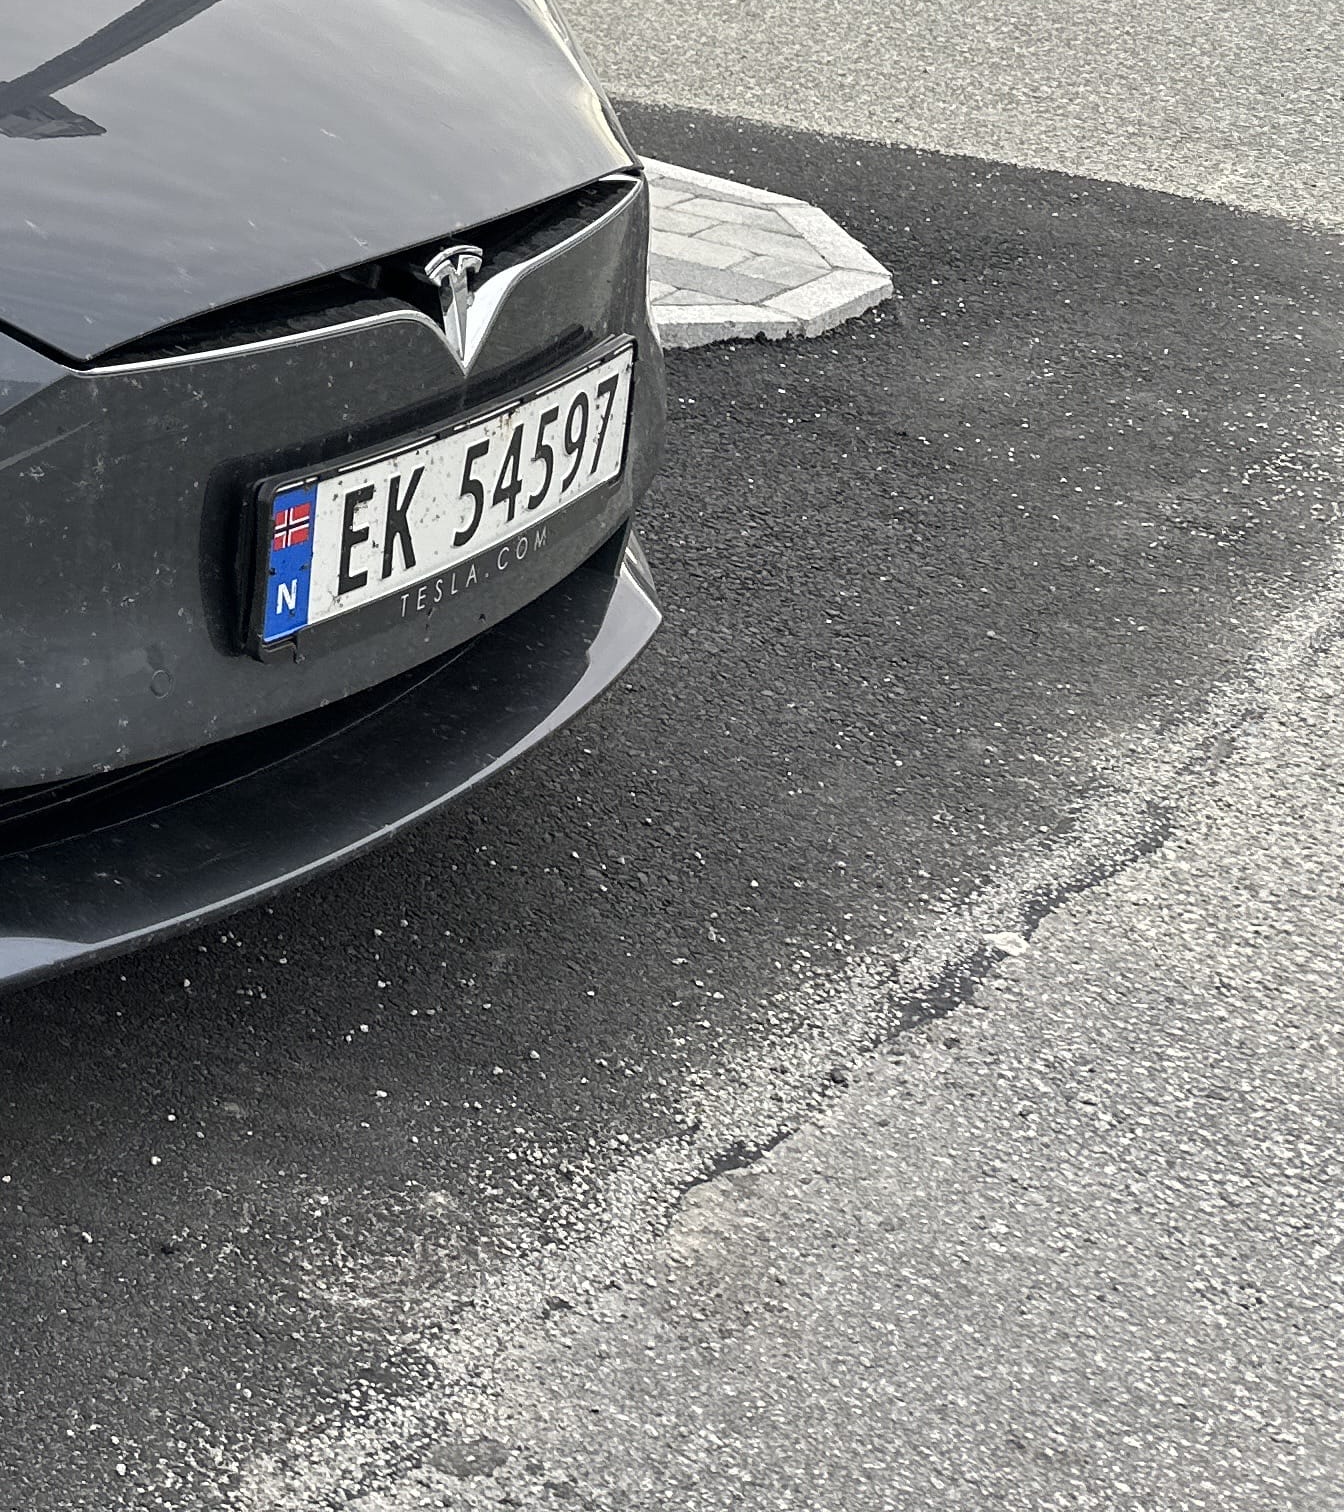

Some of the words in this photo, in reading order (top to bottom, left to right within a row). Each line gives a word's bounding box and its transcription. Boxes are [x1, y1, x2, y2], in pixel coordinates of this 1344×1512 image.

[336, 465, 425, 595] EK
[452, 373, 620, 548] 54597
[275, 578, 297, 615] N
[400, 529, 548, 618] TESLA.COM
